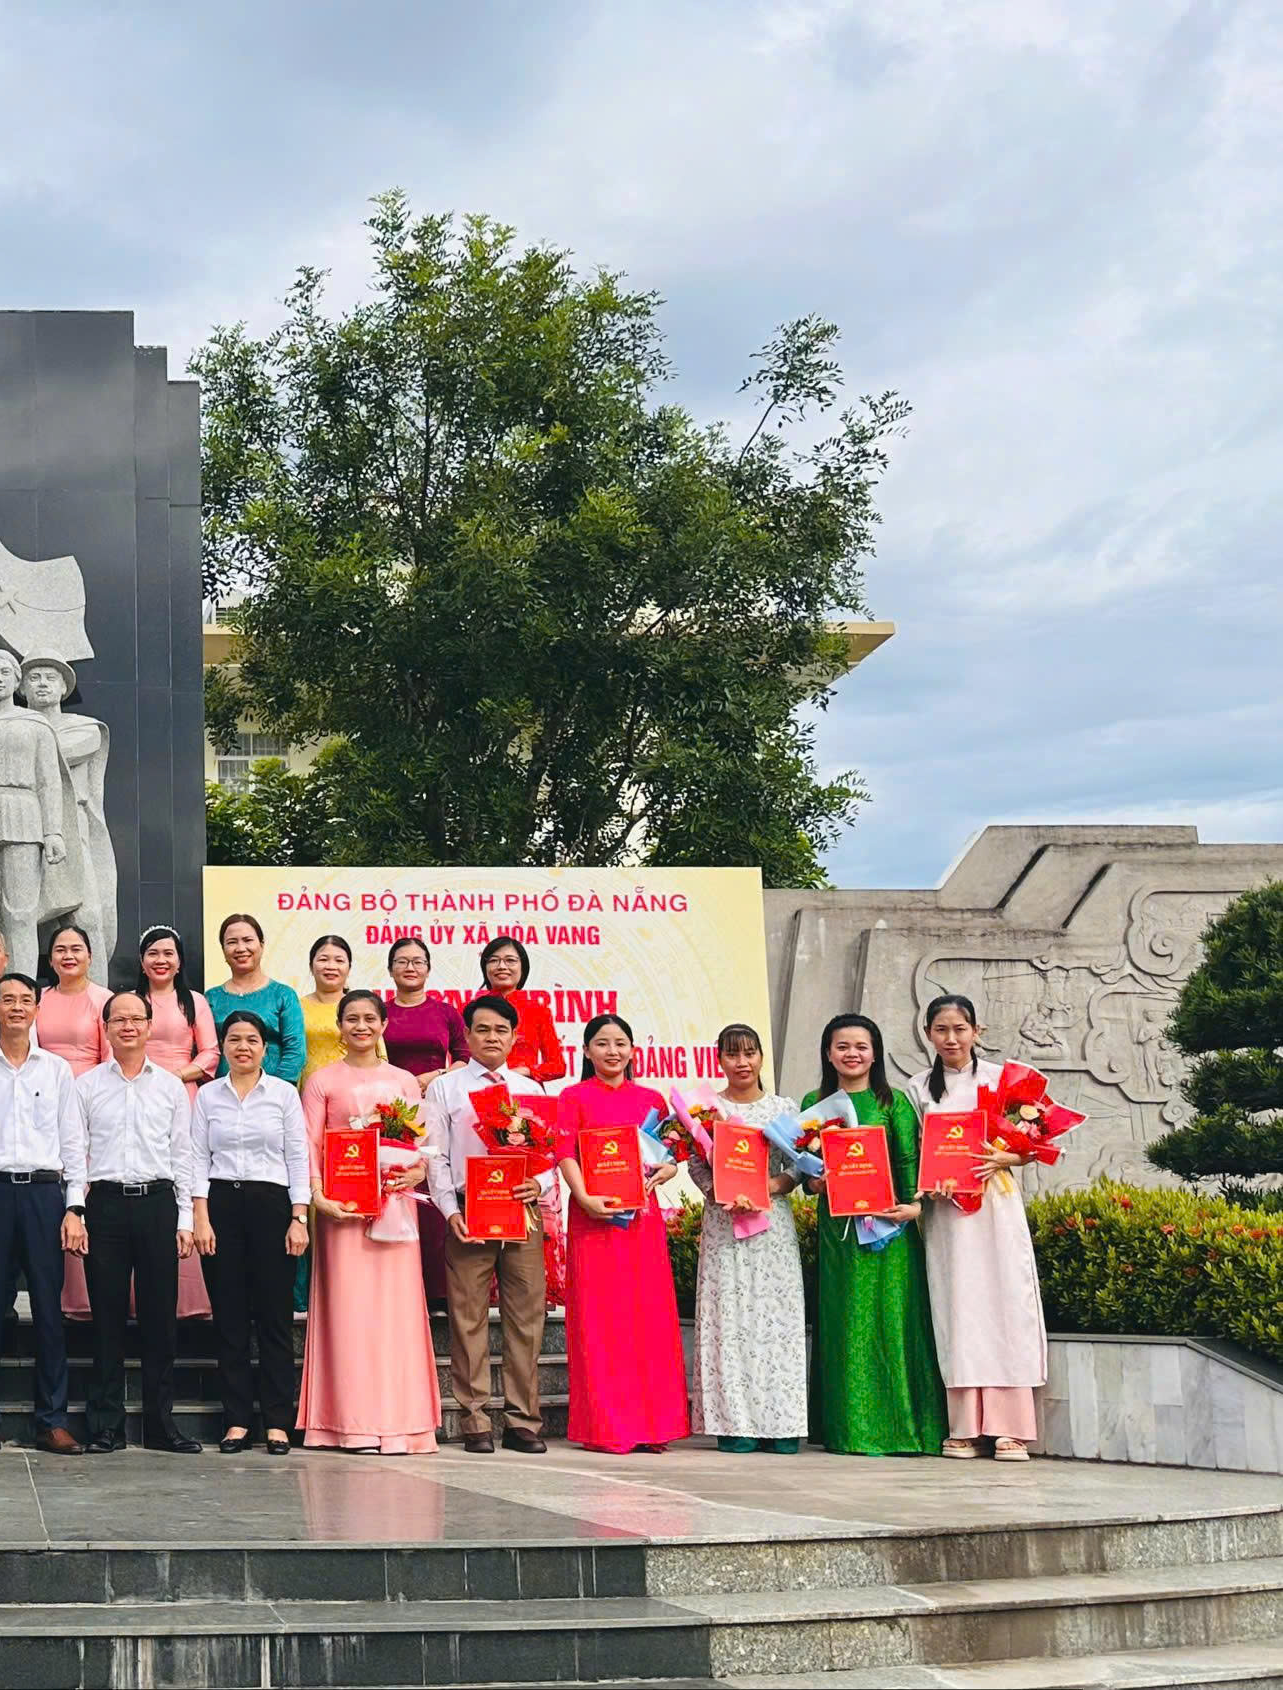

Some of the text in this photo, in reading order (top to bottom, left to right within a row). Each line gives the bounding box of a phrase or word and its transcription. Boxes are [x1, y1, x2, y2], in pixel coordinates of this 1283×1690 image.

[277, 885, 688, 915] ĐẢNG BỘ THÀNH PHỐ ĐÀ NẴNG
[365, 918, 600, 945] ĐẢNG ỦY XÃ HÒA VANG
